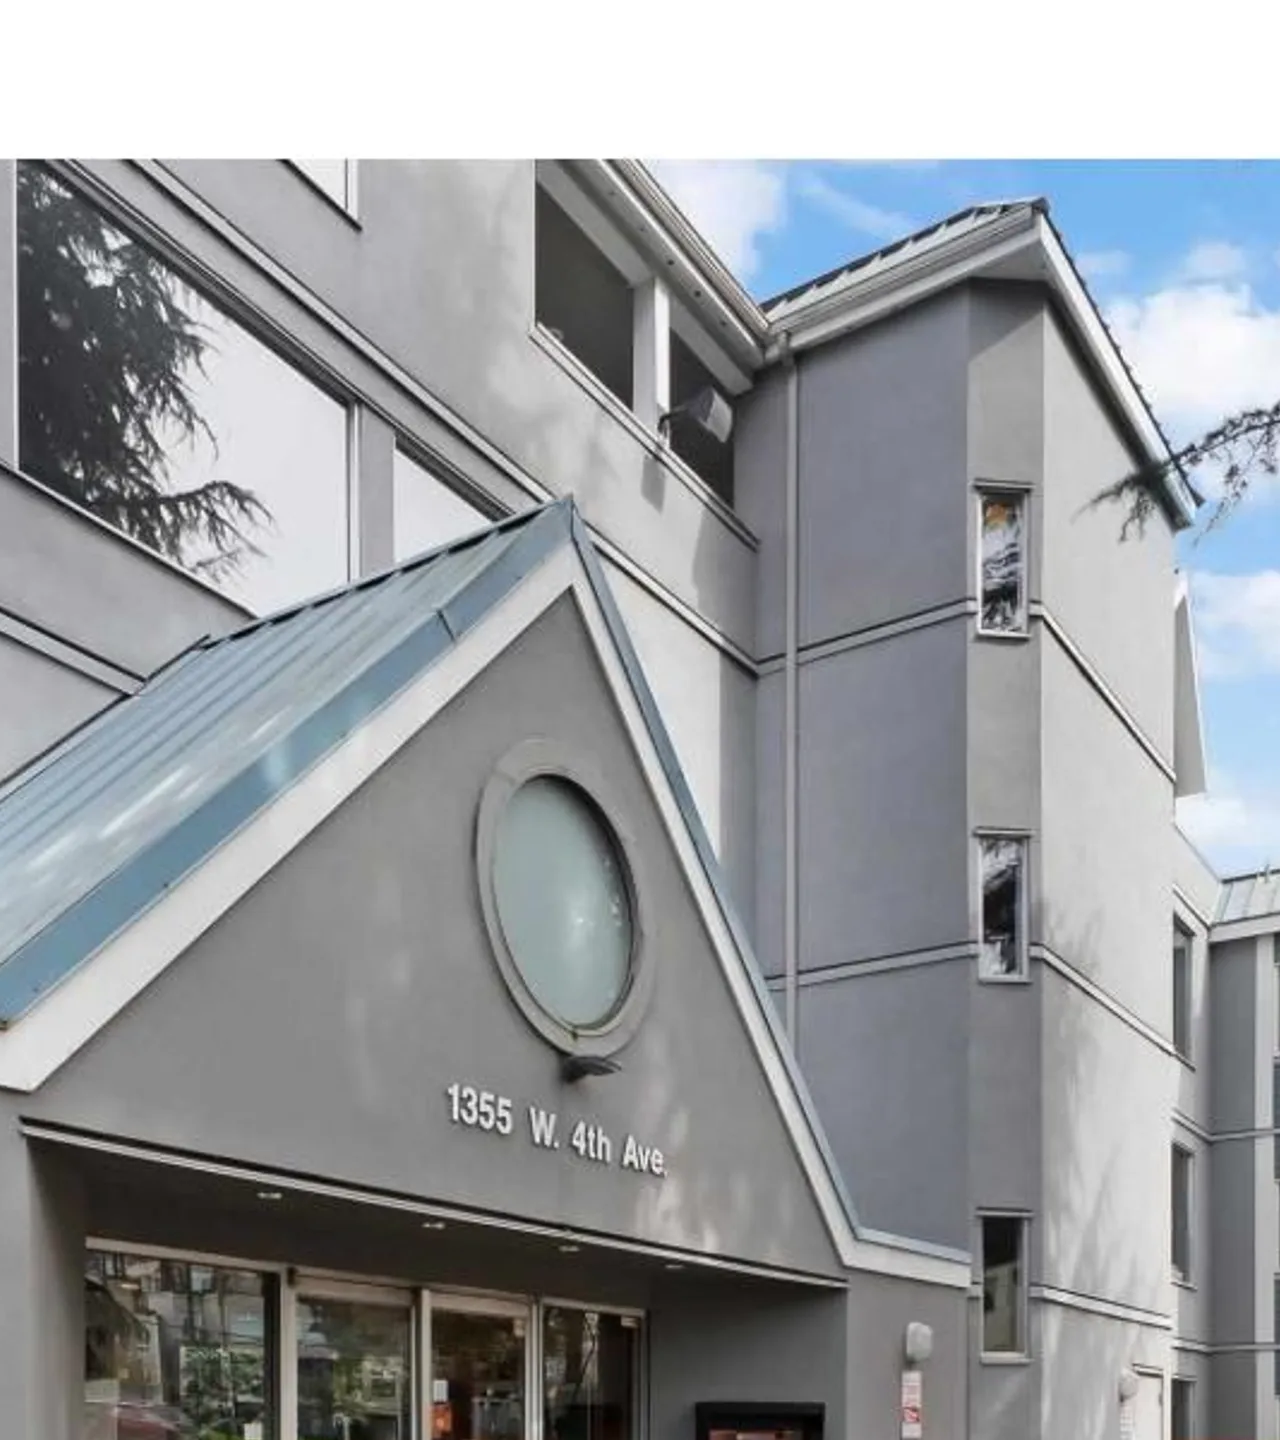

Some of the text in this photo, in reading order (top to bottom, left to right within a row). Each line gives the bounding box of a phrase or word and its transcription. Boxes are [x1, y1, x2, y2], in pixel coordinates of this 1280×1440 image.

[447, 1082, 670, 1178] 1355 W. 4th Ave.
